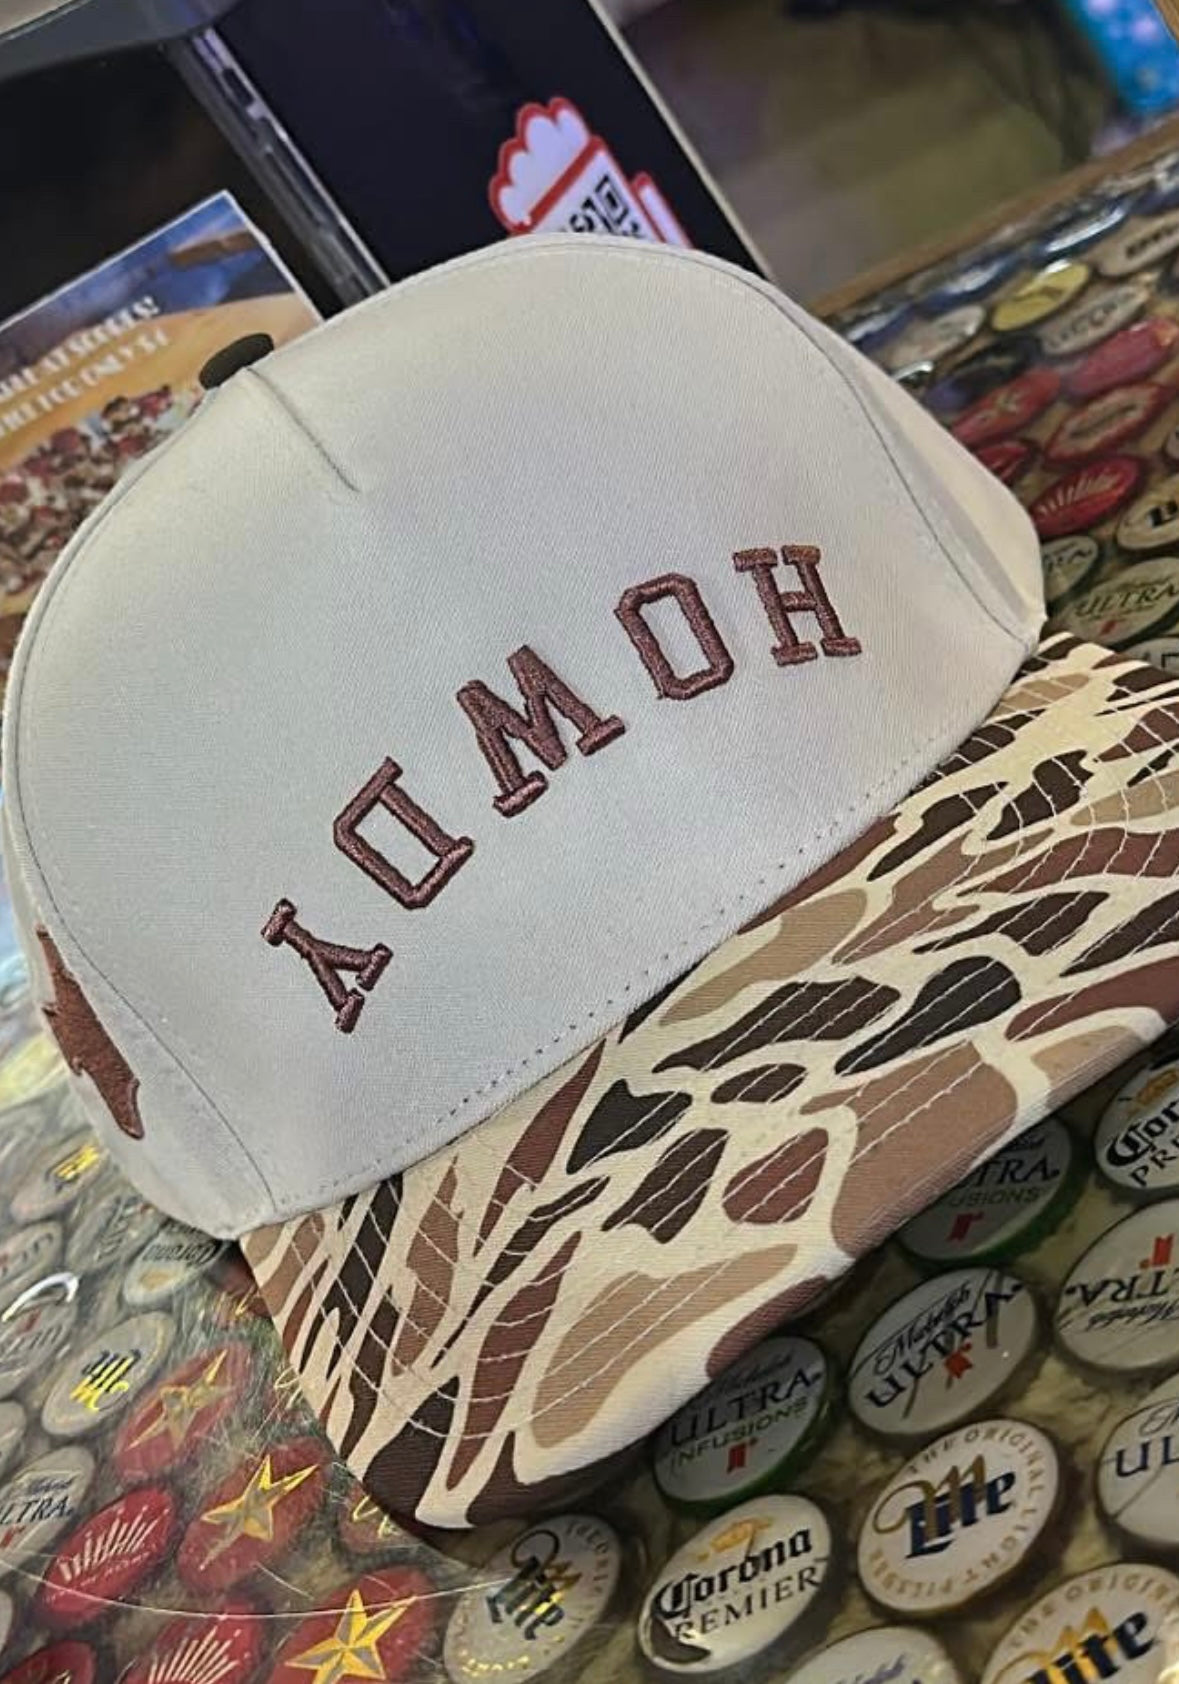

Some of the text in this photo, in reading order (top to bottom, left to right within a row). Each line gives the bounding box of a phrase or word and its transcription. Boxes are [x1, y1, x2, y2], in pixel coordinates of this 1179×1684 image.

[261, 545, 862, 1034] HOWDY
[905, 1470, 1017, 1560] Lite
[653, 1527, 813, 1610] Corona
[675, 1565, 822, 1640] REMIER
